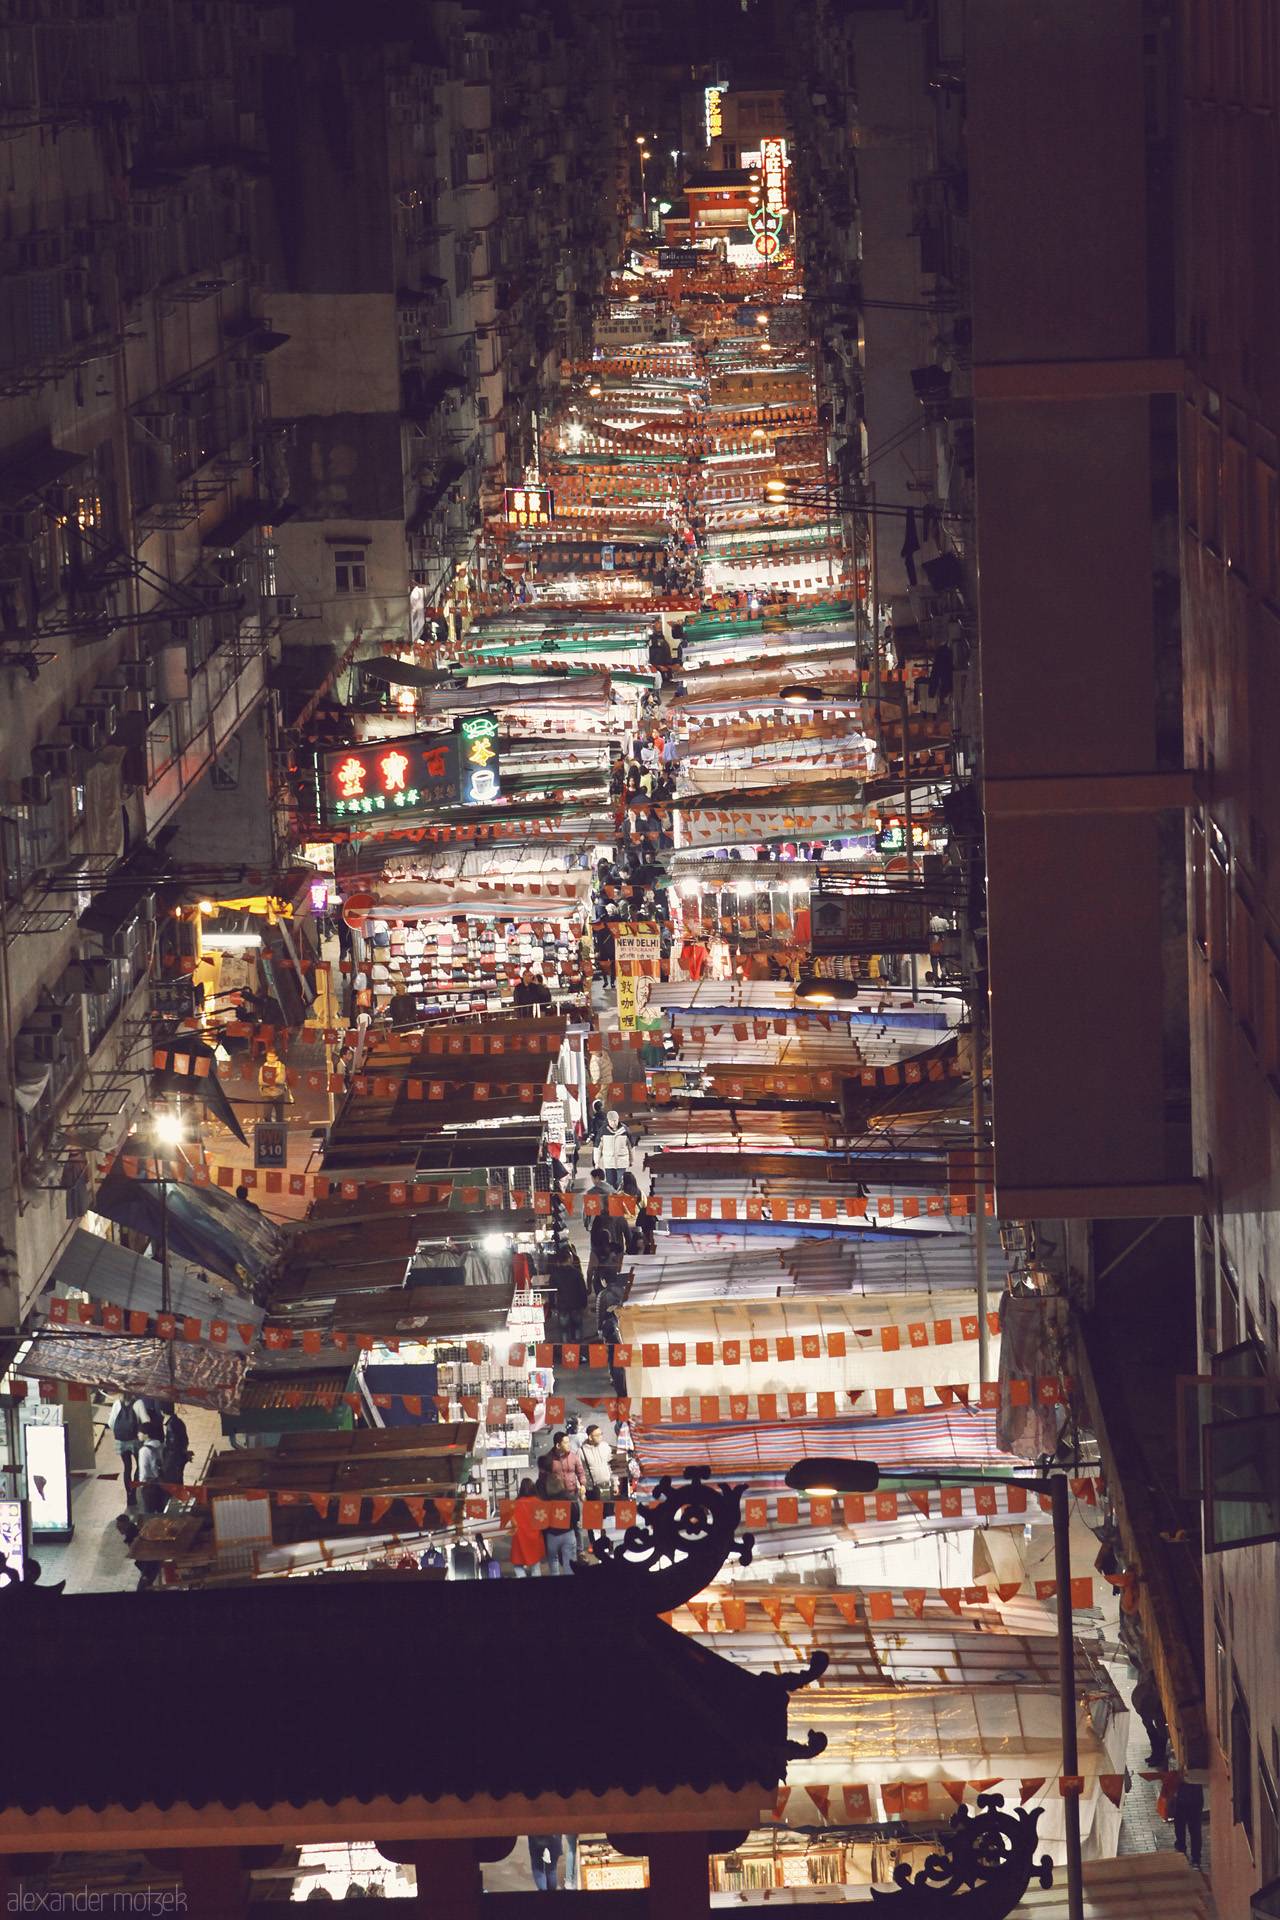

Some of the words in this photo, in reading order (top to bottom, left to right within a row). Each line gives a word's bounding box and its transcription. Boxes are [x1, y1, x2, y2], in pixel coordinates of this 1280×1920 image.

[849, 899, 868, 919] ASIAN
[870, 900, 891, 919] CURRY
[893, 900, 921, 919] KITCHEN
[617, 938, 635, 948] NEW
[636, 938, 659, 948] DELHI
[259, 1144, 282, 1156] $10
[32, 1406, 62, 1426] 124
